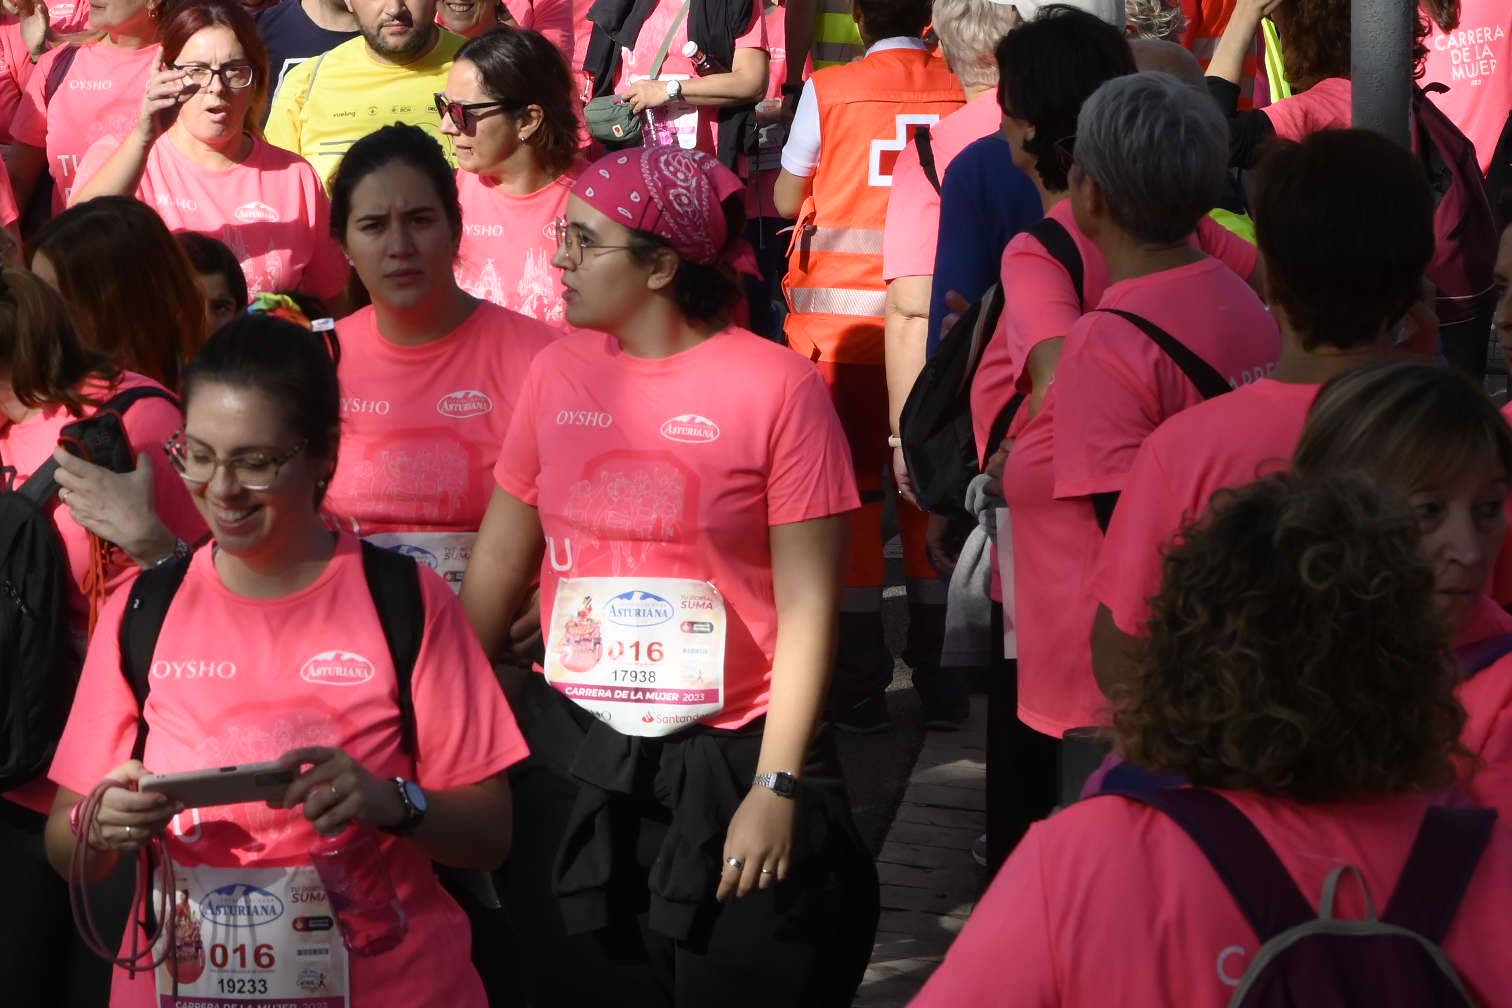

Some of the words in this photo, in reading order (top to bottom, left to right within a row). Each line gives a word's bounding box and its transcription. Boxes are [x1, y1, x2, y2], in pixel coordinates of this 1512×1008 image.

[1434, 24, 1505, 51] CARRERA
[1451, 47, 1471, 65] DE
[1475, 43, 1495, 61] LA
[69, 79, 112, 91] OYSHO
[463, 224, 504, 237] YSHO
[341, 398, 390, 416] YSHO
[442, 398, 489, 414] ASTURIANA
[555, 410, 613, 429] OYSHO
[664, 421, 717, 440] ASTURIANA
[609, 605, 669, 619] ASTURIANA
[681, 600, 713, 610] SUMA
[608, 640, 665, 663] 016
[151, 659, 237, 680] OYSHO
[306, 661, 370, 681] ASTURIANA
[611, 670, 657, 684] 17938
[565, 686, 612, 698] CARRERA
[614, 688, 628, 699] DE
[630, 689, 644, 700] LA
[645, 690, 680, 702] MUJER
[682, 693, 705, 702] 2023
[172, 807, 200, 842] U
[209, 901, 277, 917] ASTURIANA
[209, 943, 276, 970] 016
[217, 978, 268, 995] 19233
